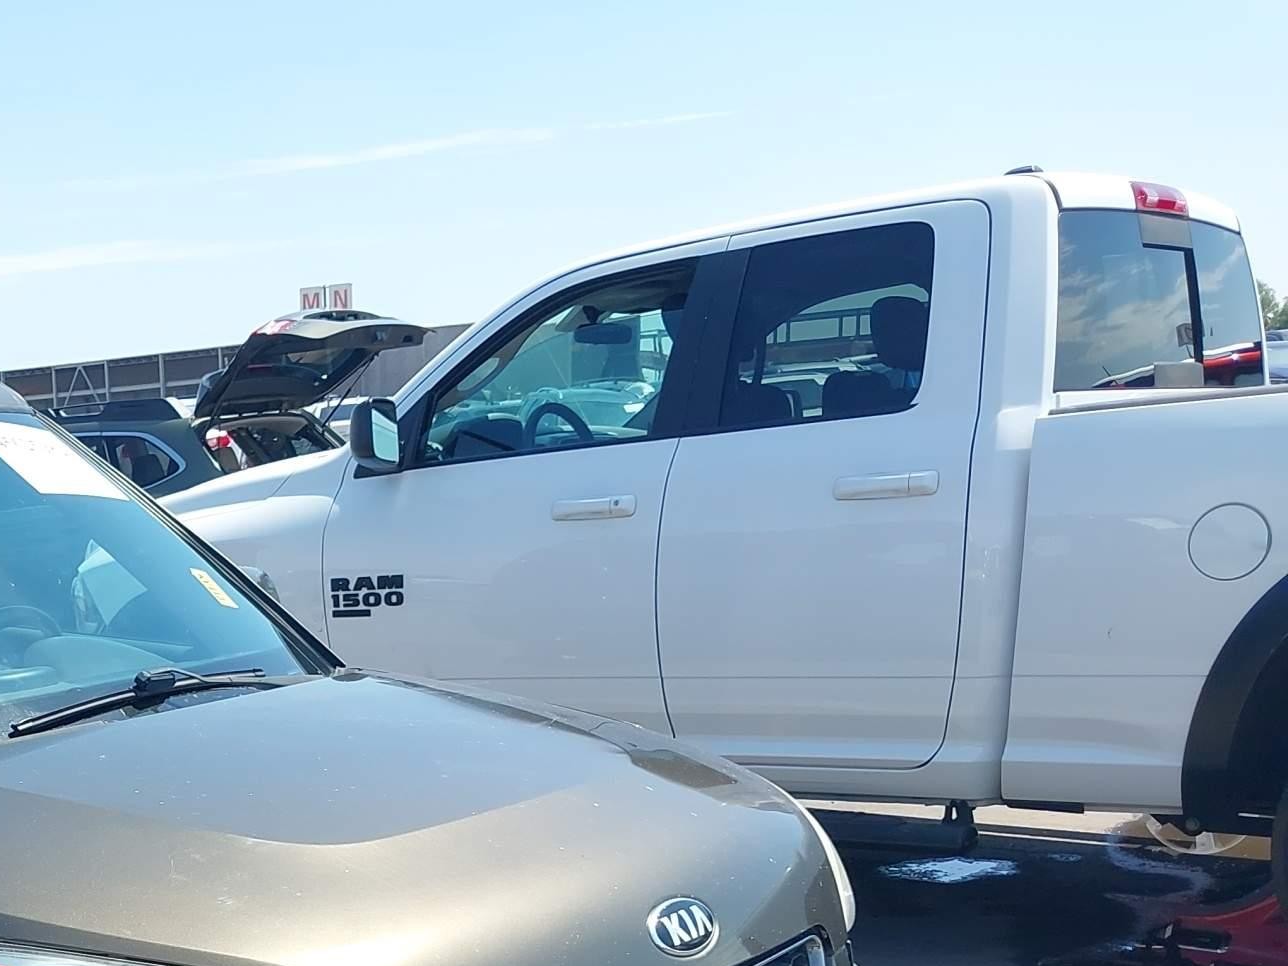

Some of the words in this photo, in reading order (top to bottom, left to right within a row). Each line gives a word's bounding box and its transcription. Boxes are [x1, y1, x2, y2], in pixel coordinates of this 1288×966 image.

[302, 292, 320, 310] M
[334, 289, 347, 309] N
[330, 574, 404, 592] RAM
[331, 591, 404, 608] 1500
[659, 904, 713, 947] KIA
